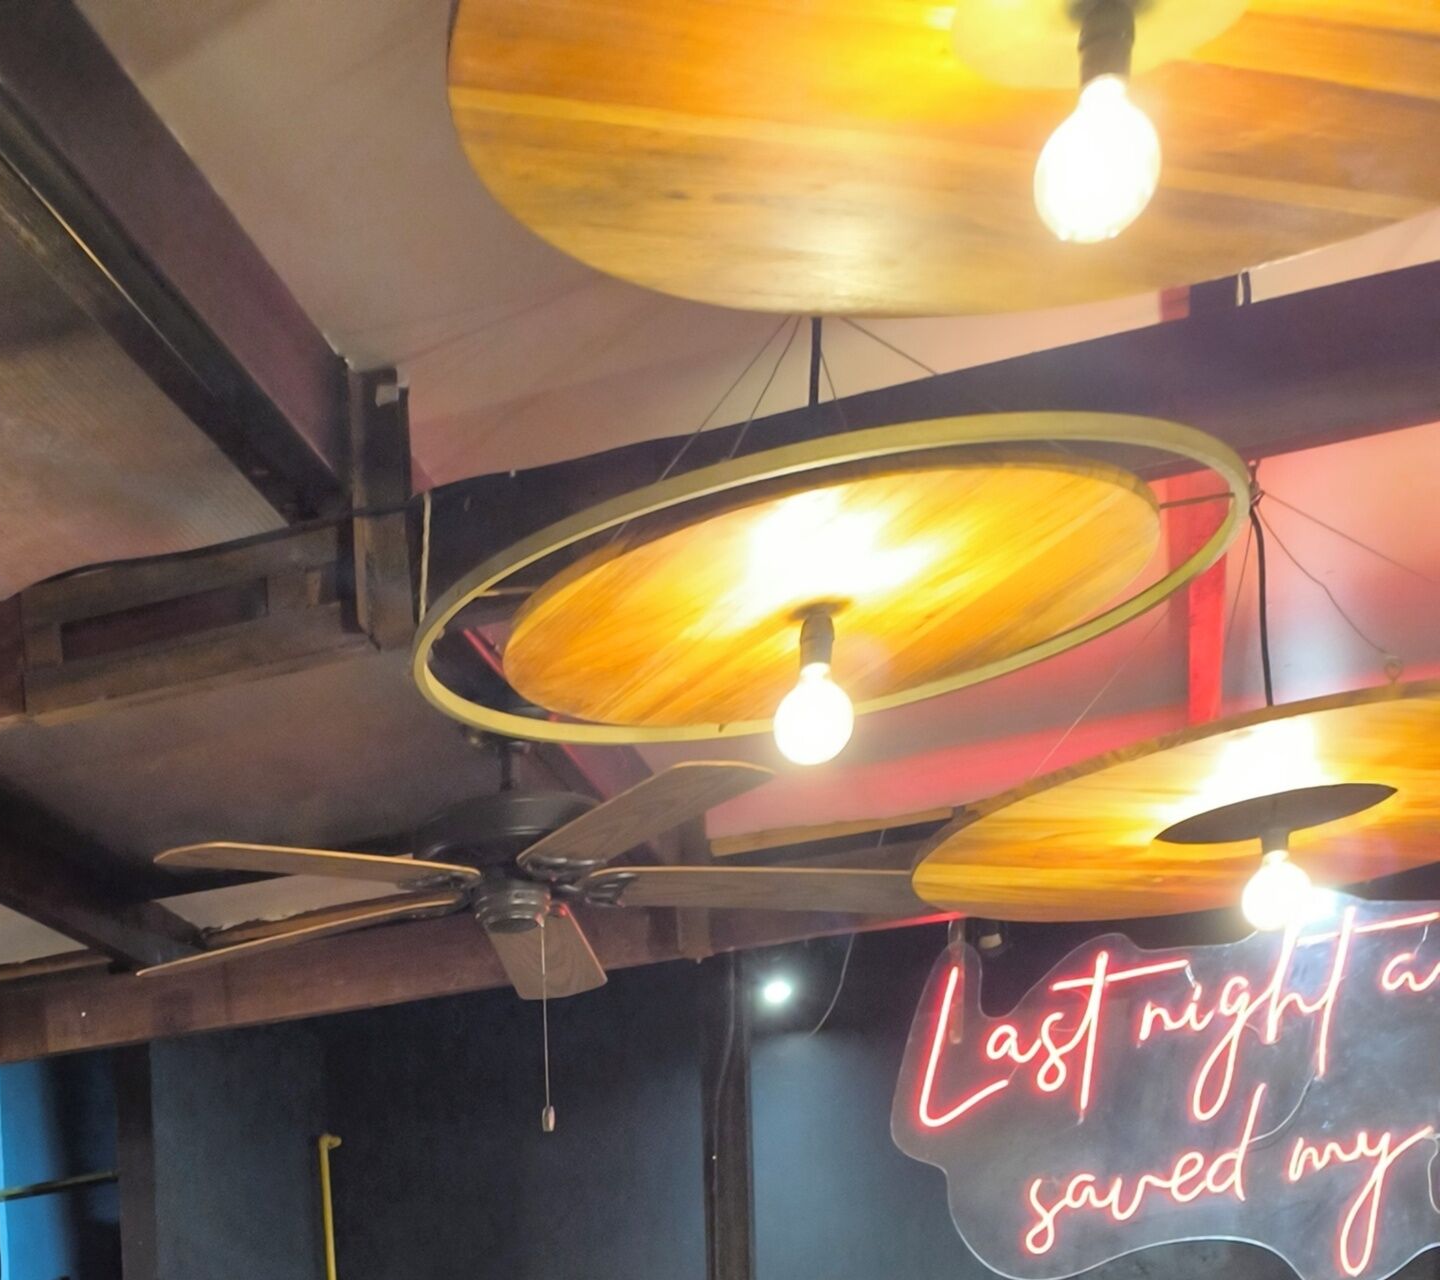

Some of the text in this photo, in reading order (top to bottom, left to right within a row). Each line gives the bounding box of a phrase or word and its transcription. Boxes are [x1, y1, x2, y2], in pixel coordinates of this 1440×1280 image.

[919, 950, 1189, 1128] Last
[1138, 905, 1439, 1121] night
[1025, 1083, 1433, 1276] saved my
